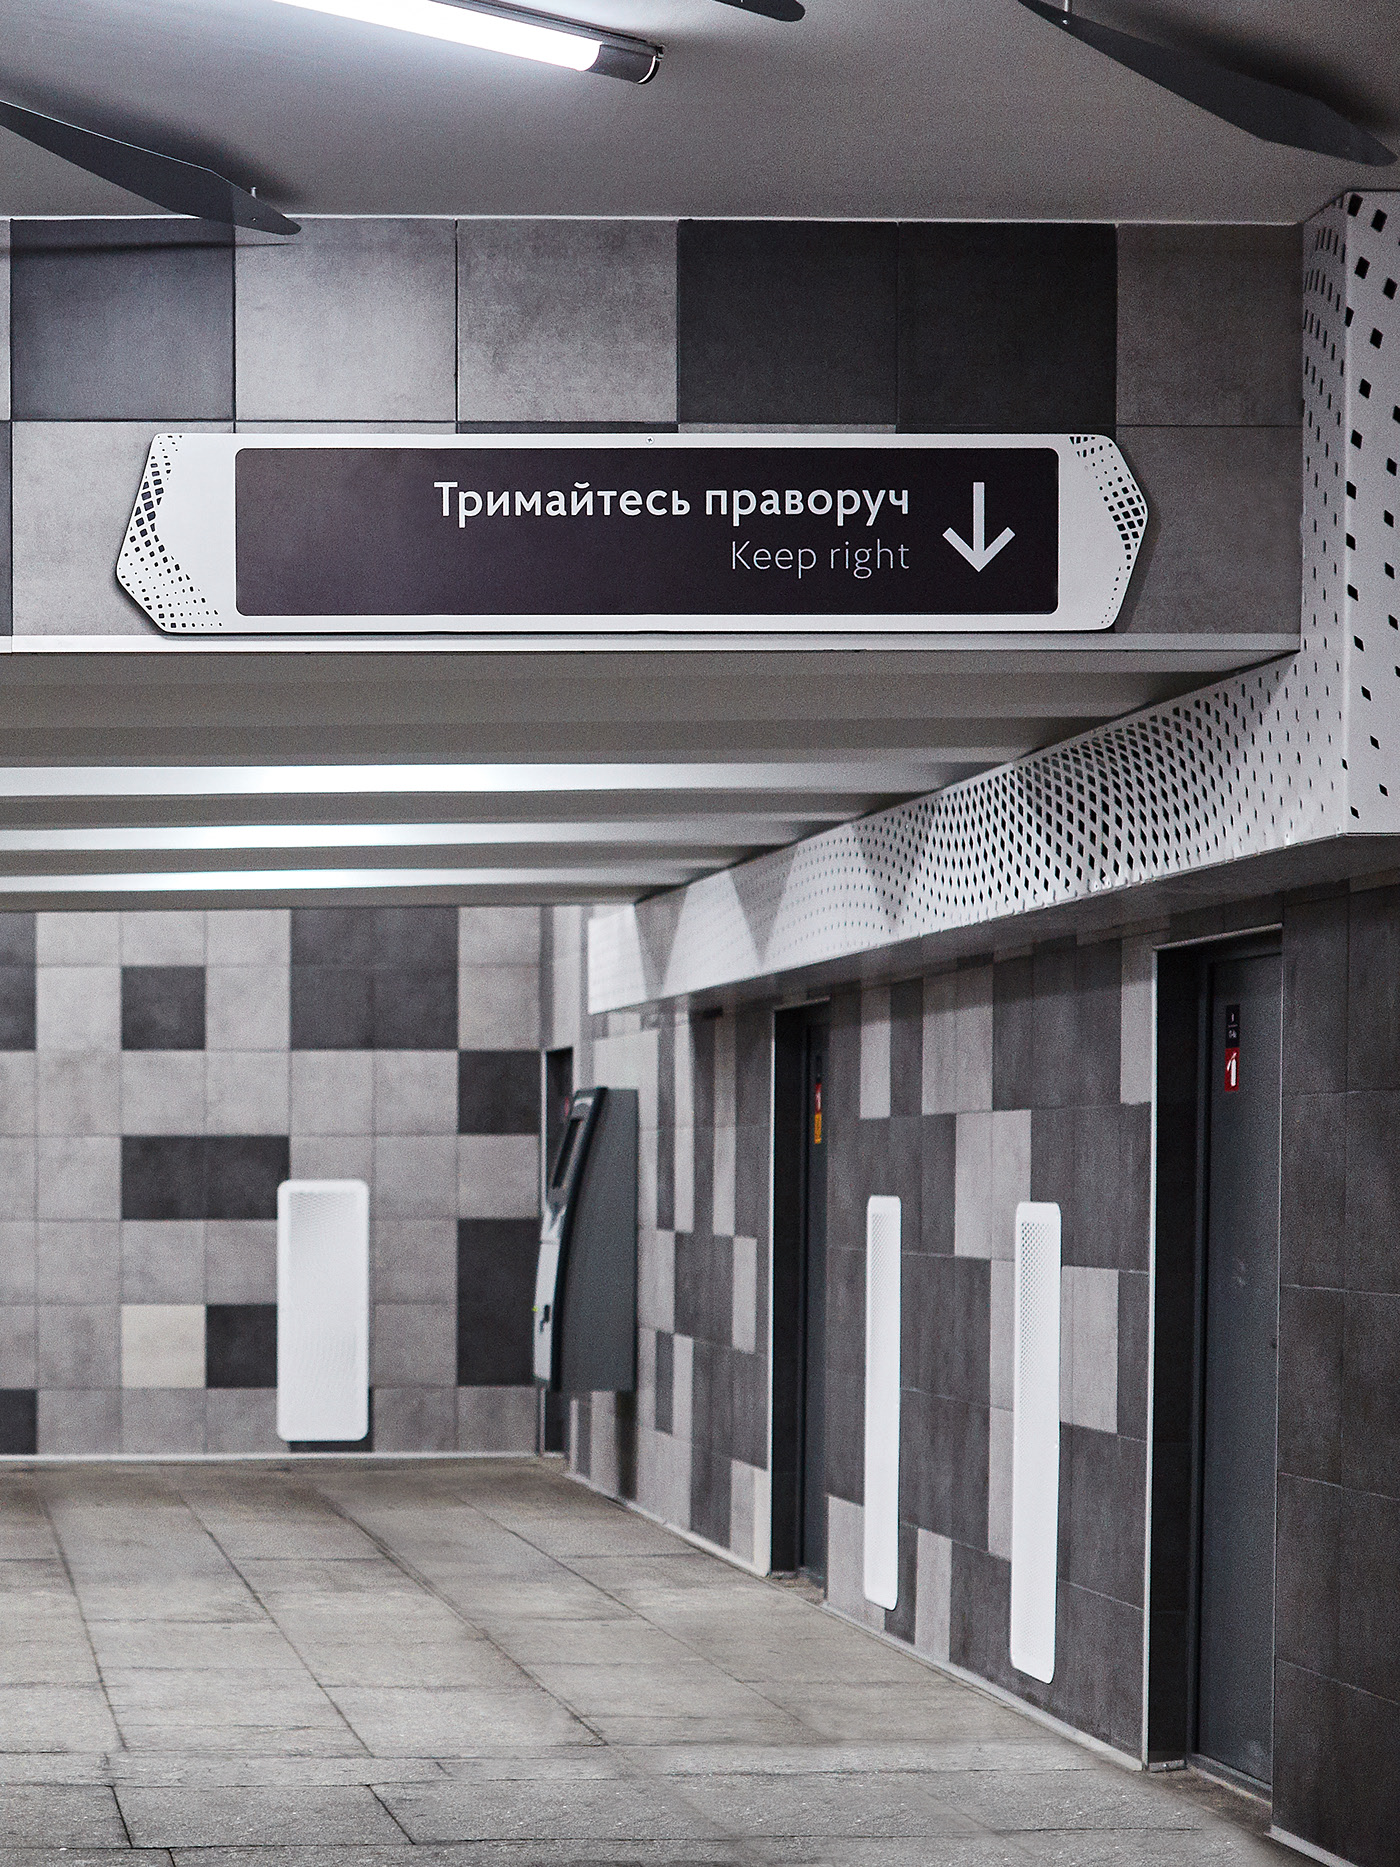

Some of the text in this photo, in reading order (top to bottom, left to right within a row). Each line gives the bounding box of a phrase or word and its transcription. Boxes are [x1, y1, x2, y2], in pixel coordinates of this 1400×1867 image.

[433, 481, 909, 529] Тримайтесь праворуч
[731, 538, 910, 579] Keep right
